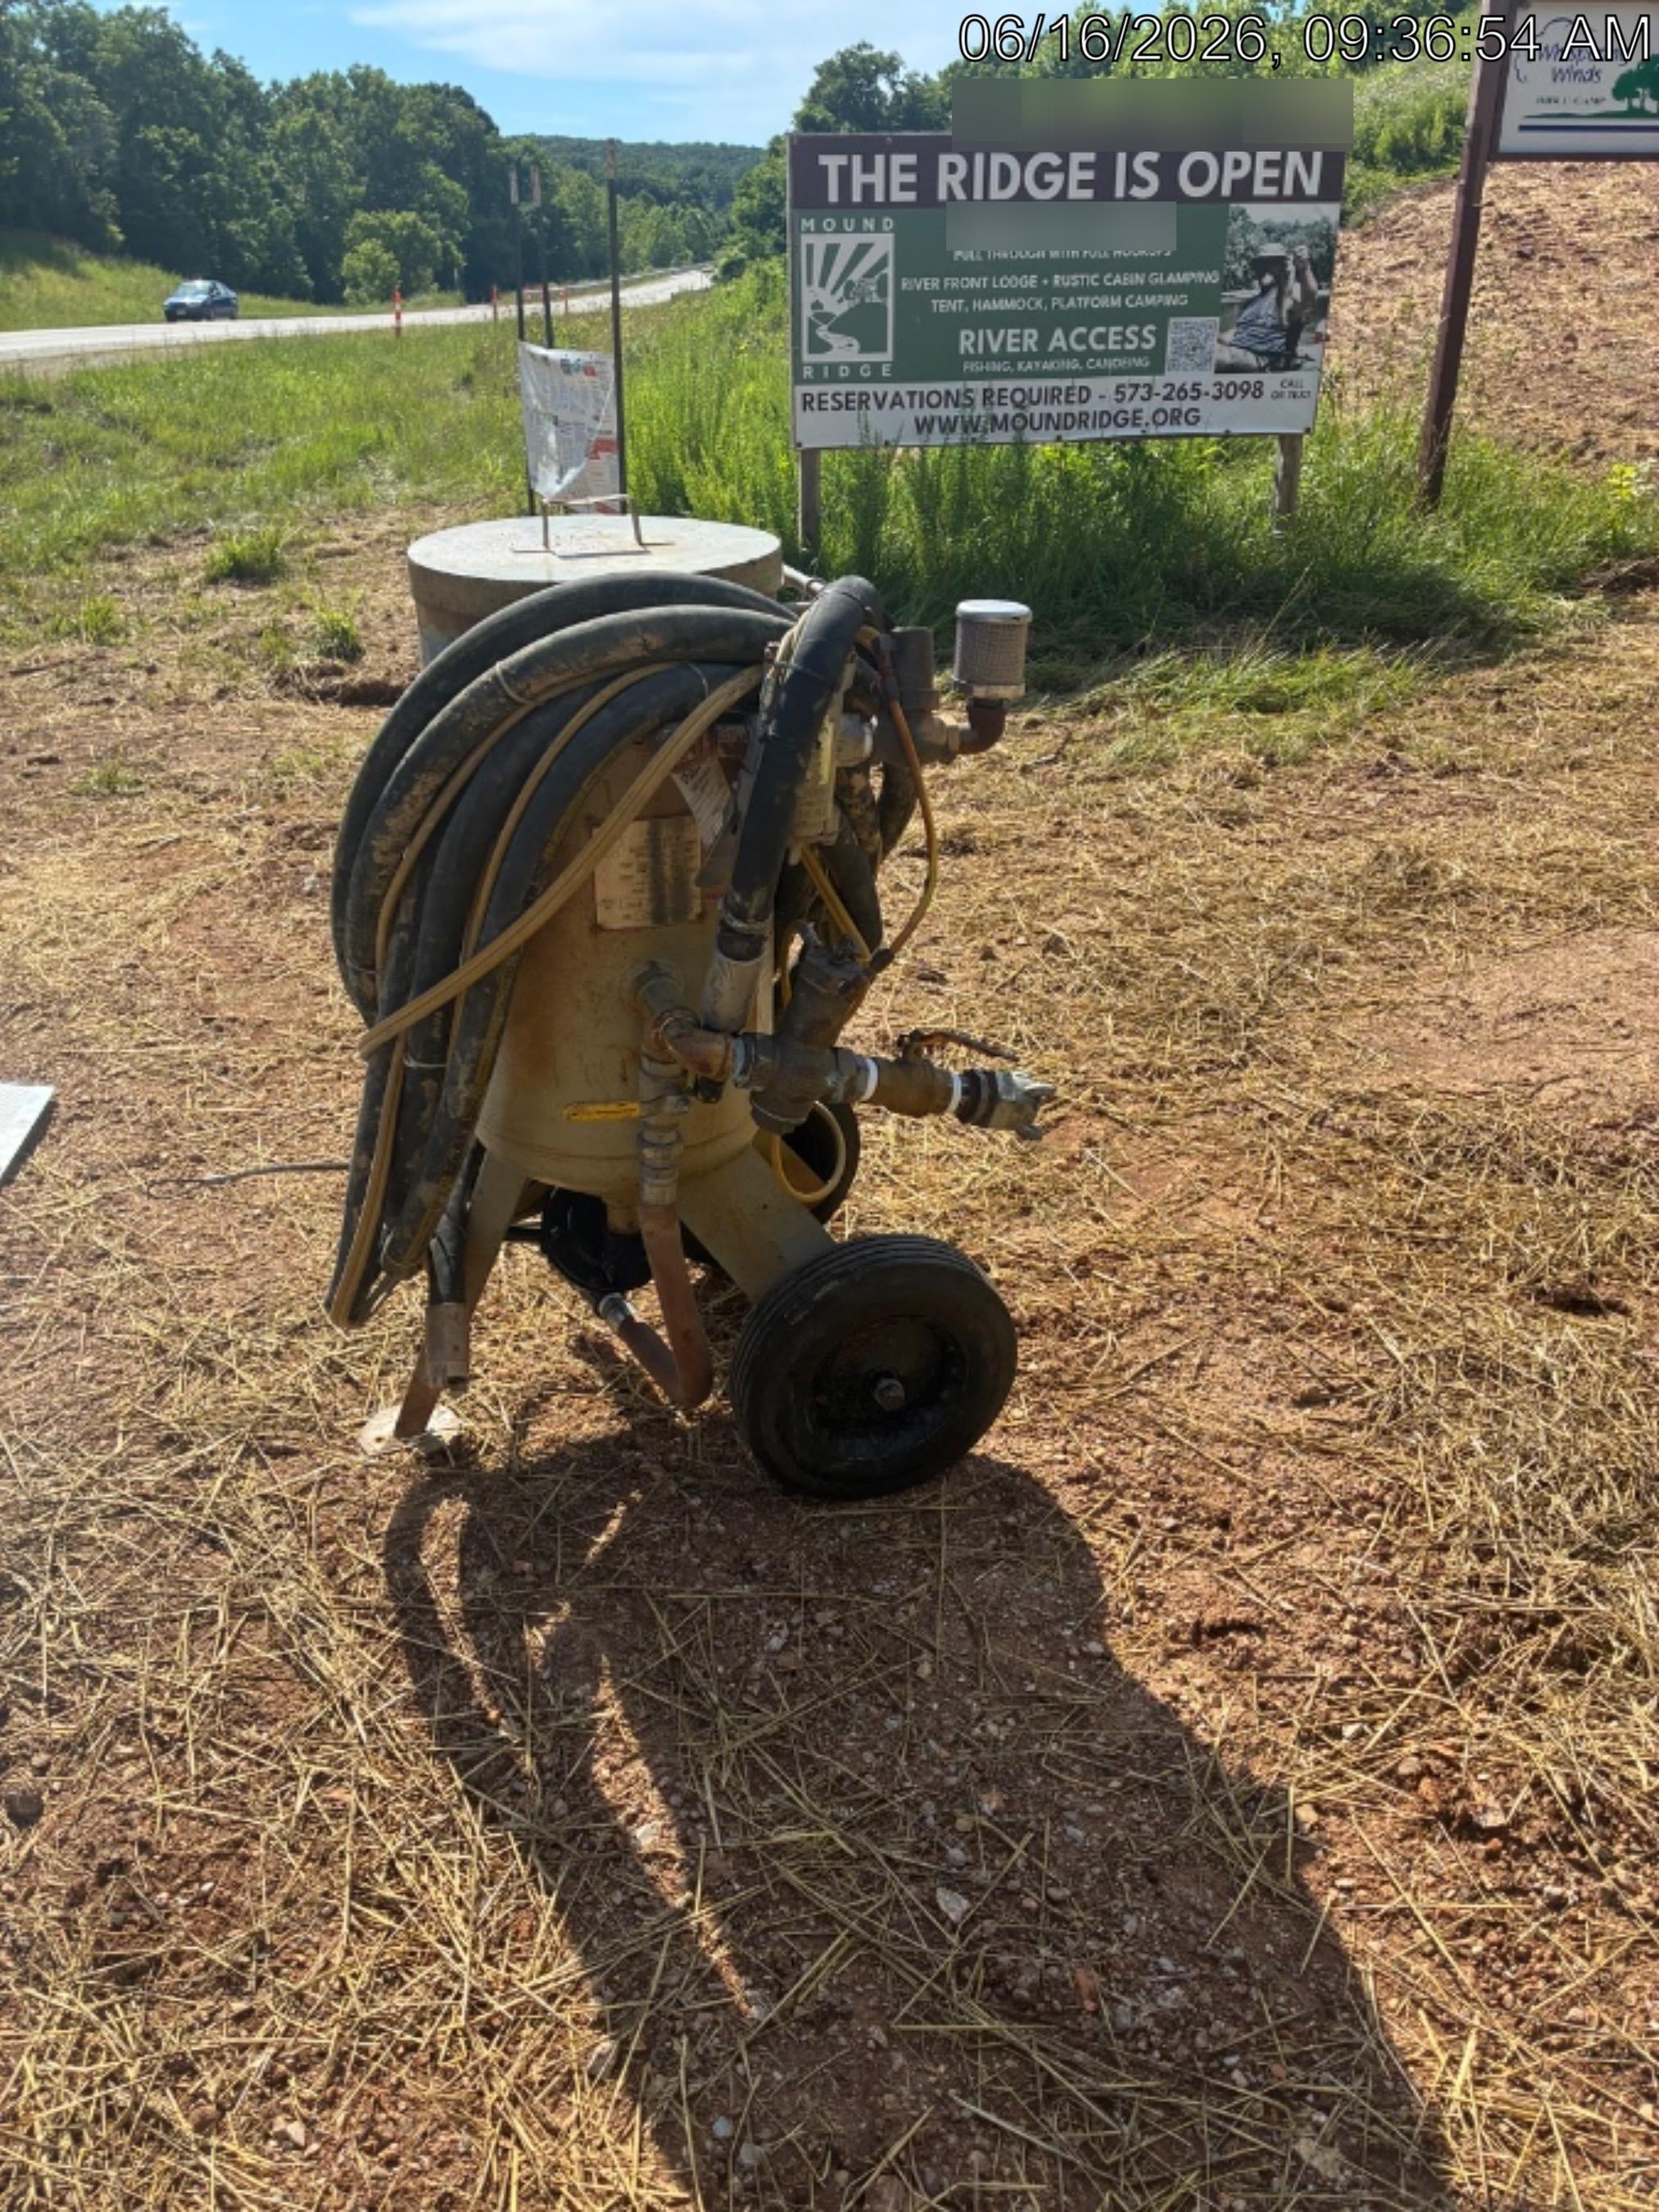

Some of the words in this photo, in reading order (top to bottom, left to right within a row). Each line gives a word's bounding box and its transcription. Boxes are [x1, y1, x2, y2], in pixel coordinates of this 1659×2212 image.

[818, 154, 918, 203] THE
[938, 152, 1096, 202] RIDGE
[1114, 151, 1161, 199] IS
[1178, 151, 1323, 198] OPEN
[800, 217, 895, 232] MOUND
[901, 276, 941, 291] RIVER
[944, 276, 989, 290] FRONT
[992, 274, 1038, 289] LODGE
[1053, 274, 1099, 288] RUSTIC
[1103, 272, 1145, 286] CABIN
[1148, 270, 1221, 284] GLAMPING
[931, 298, 969, 313] TENT,
[972, 297, 1048, 311] HAMMOCK,
[1051, 294, 1122, 310] PLATFORM
[1125, 293, 1189, 308] CAMPING
[959, 329, 1039, 355] RIVER
[1048, 324, 1157, 352] ACCESS
[803, 363, 892, 379] RIDGE
[963, 360, 1013, 374] FISHING,
[801, 387, 975, 412] RESERVATIONS
[982, 384, 1092, 408] REQUIRED
[1113, 380, 1264, 403] 573-265-3098
[913, 408, 1201, 435] WWW.MOUNDRIDGE.ORG
